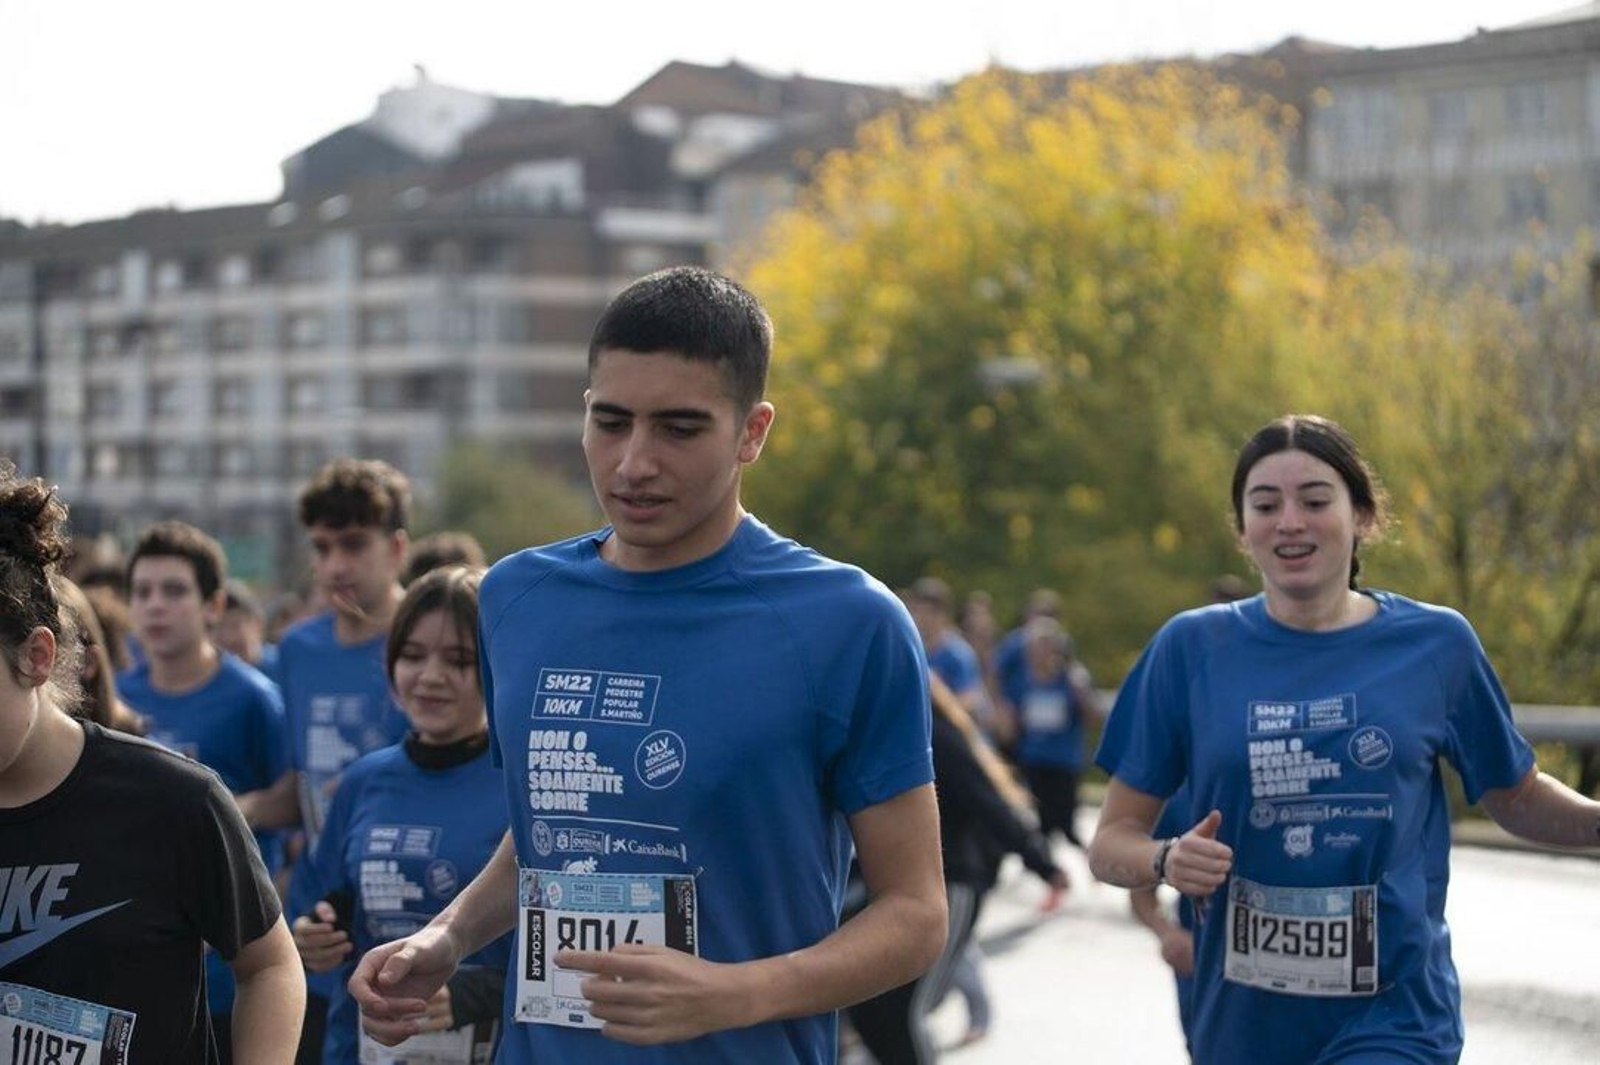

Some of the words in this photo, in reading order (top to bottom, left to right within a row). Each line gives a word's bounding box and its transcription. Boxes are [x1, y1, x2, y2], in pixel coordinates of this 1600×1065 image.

[545, 674, 592, 691] SM22
[607, 677, 645, 688] CARREIRA
[605, 688, 644, 698] PEDESTRE
[543, 698, 582, 715] 10KM
[603, 699, 639, 708] POPULAR
[529, 730, 570, 749] NON
[573, 731, 587, 750] O
[646, 737, 669, 756] XLV
[1249, 739, 1286, 755] NON
[528, 750, 615, 773] PENSES...
[646, 760, 681, 780] OURENSE
[528, 770, 624, 794] SOAMENTE
[1251, 762, 1342, 783] SOAMENTE
[1252, 779, 1310, 798] CORRE
[529, 791, 589, 811] CORRE
[627, 840, 681, 858] CaixaBank
[1252, 914, 1348, 958] 12599
[532, 915, 542, 977] ESCOLAR
